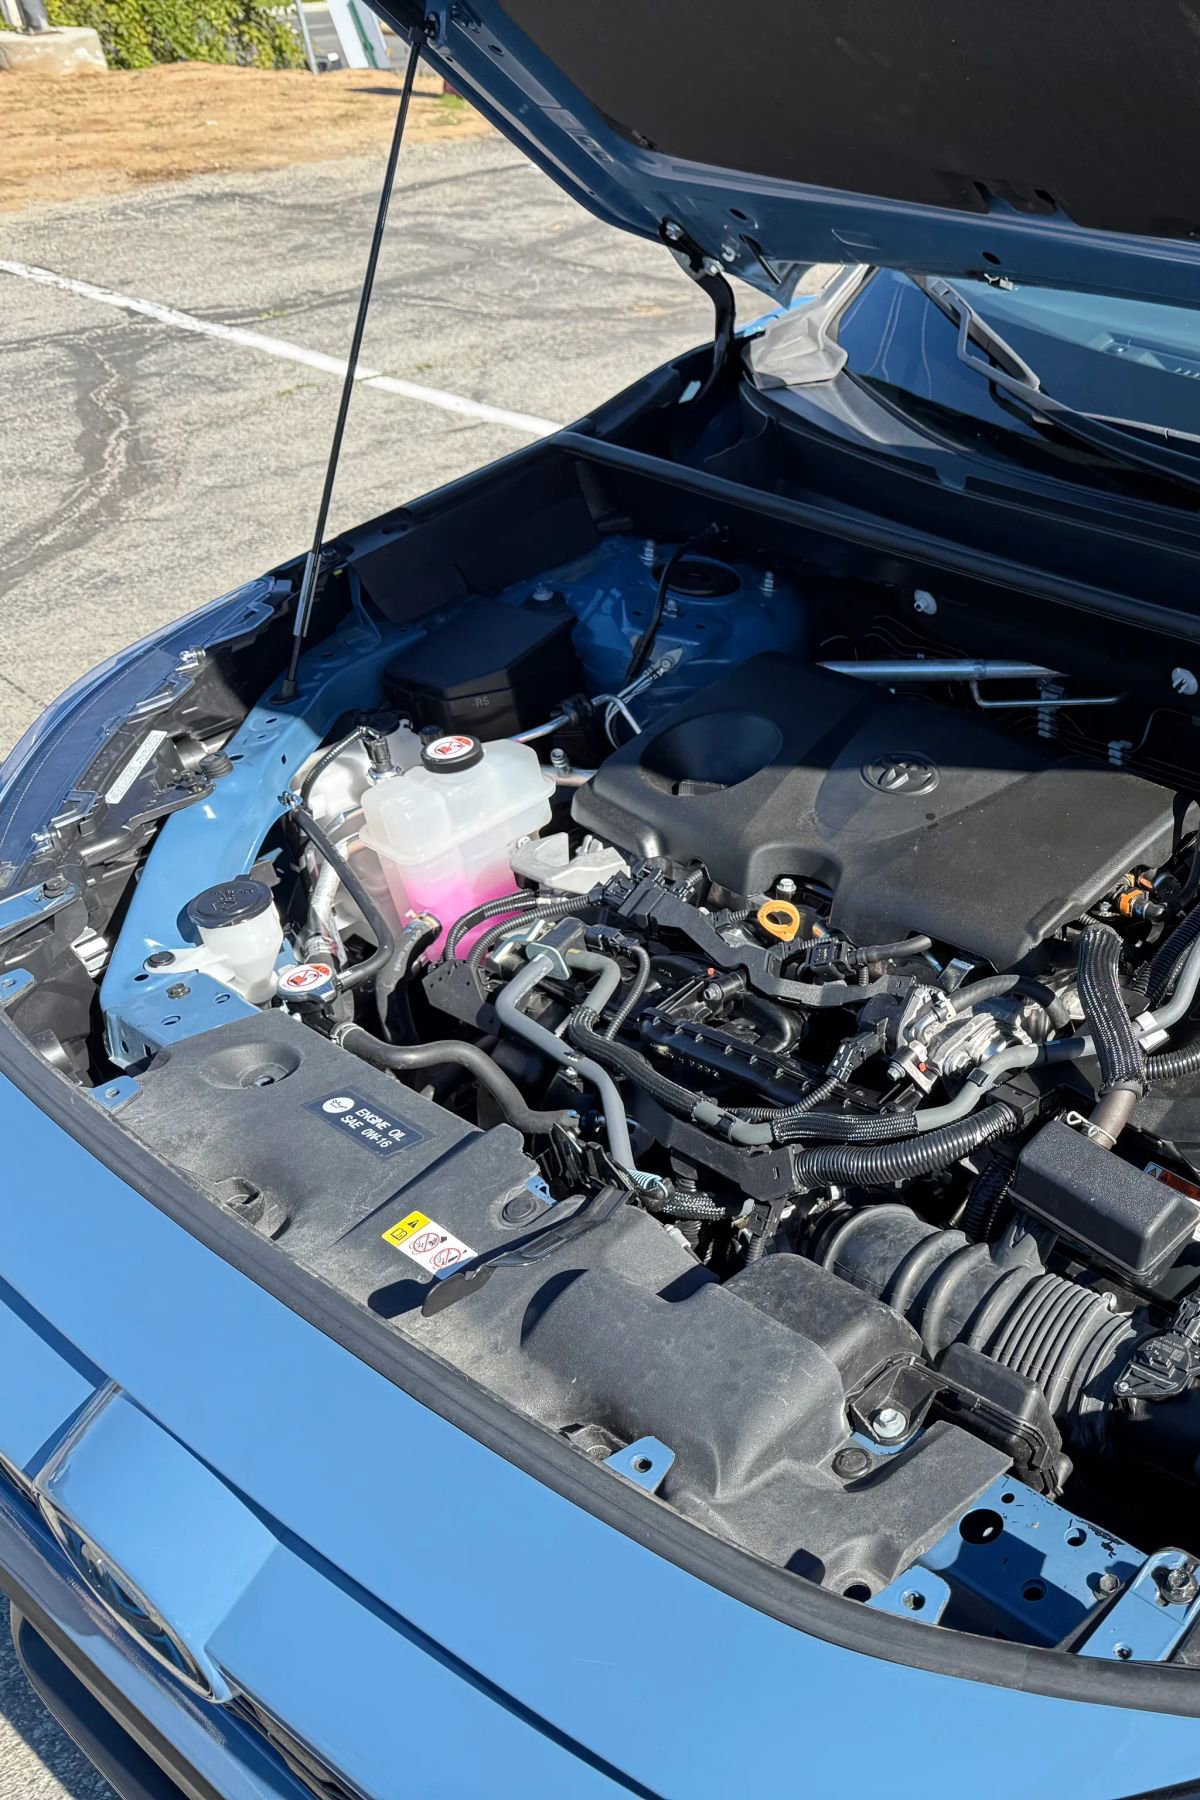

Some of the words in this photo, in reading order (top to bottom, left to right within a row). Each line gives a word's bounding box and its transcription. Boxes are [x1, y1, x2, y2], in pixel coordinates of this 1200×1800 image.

[340, 1115, 364, 1129] SAE
[361, 1128, 392, 1147] 0W-16
[355, 1108, 391, 1130] ENGINE
[388, 1129, 406, 1141] OIL
